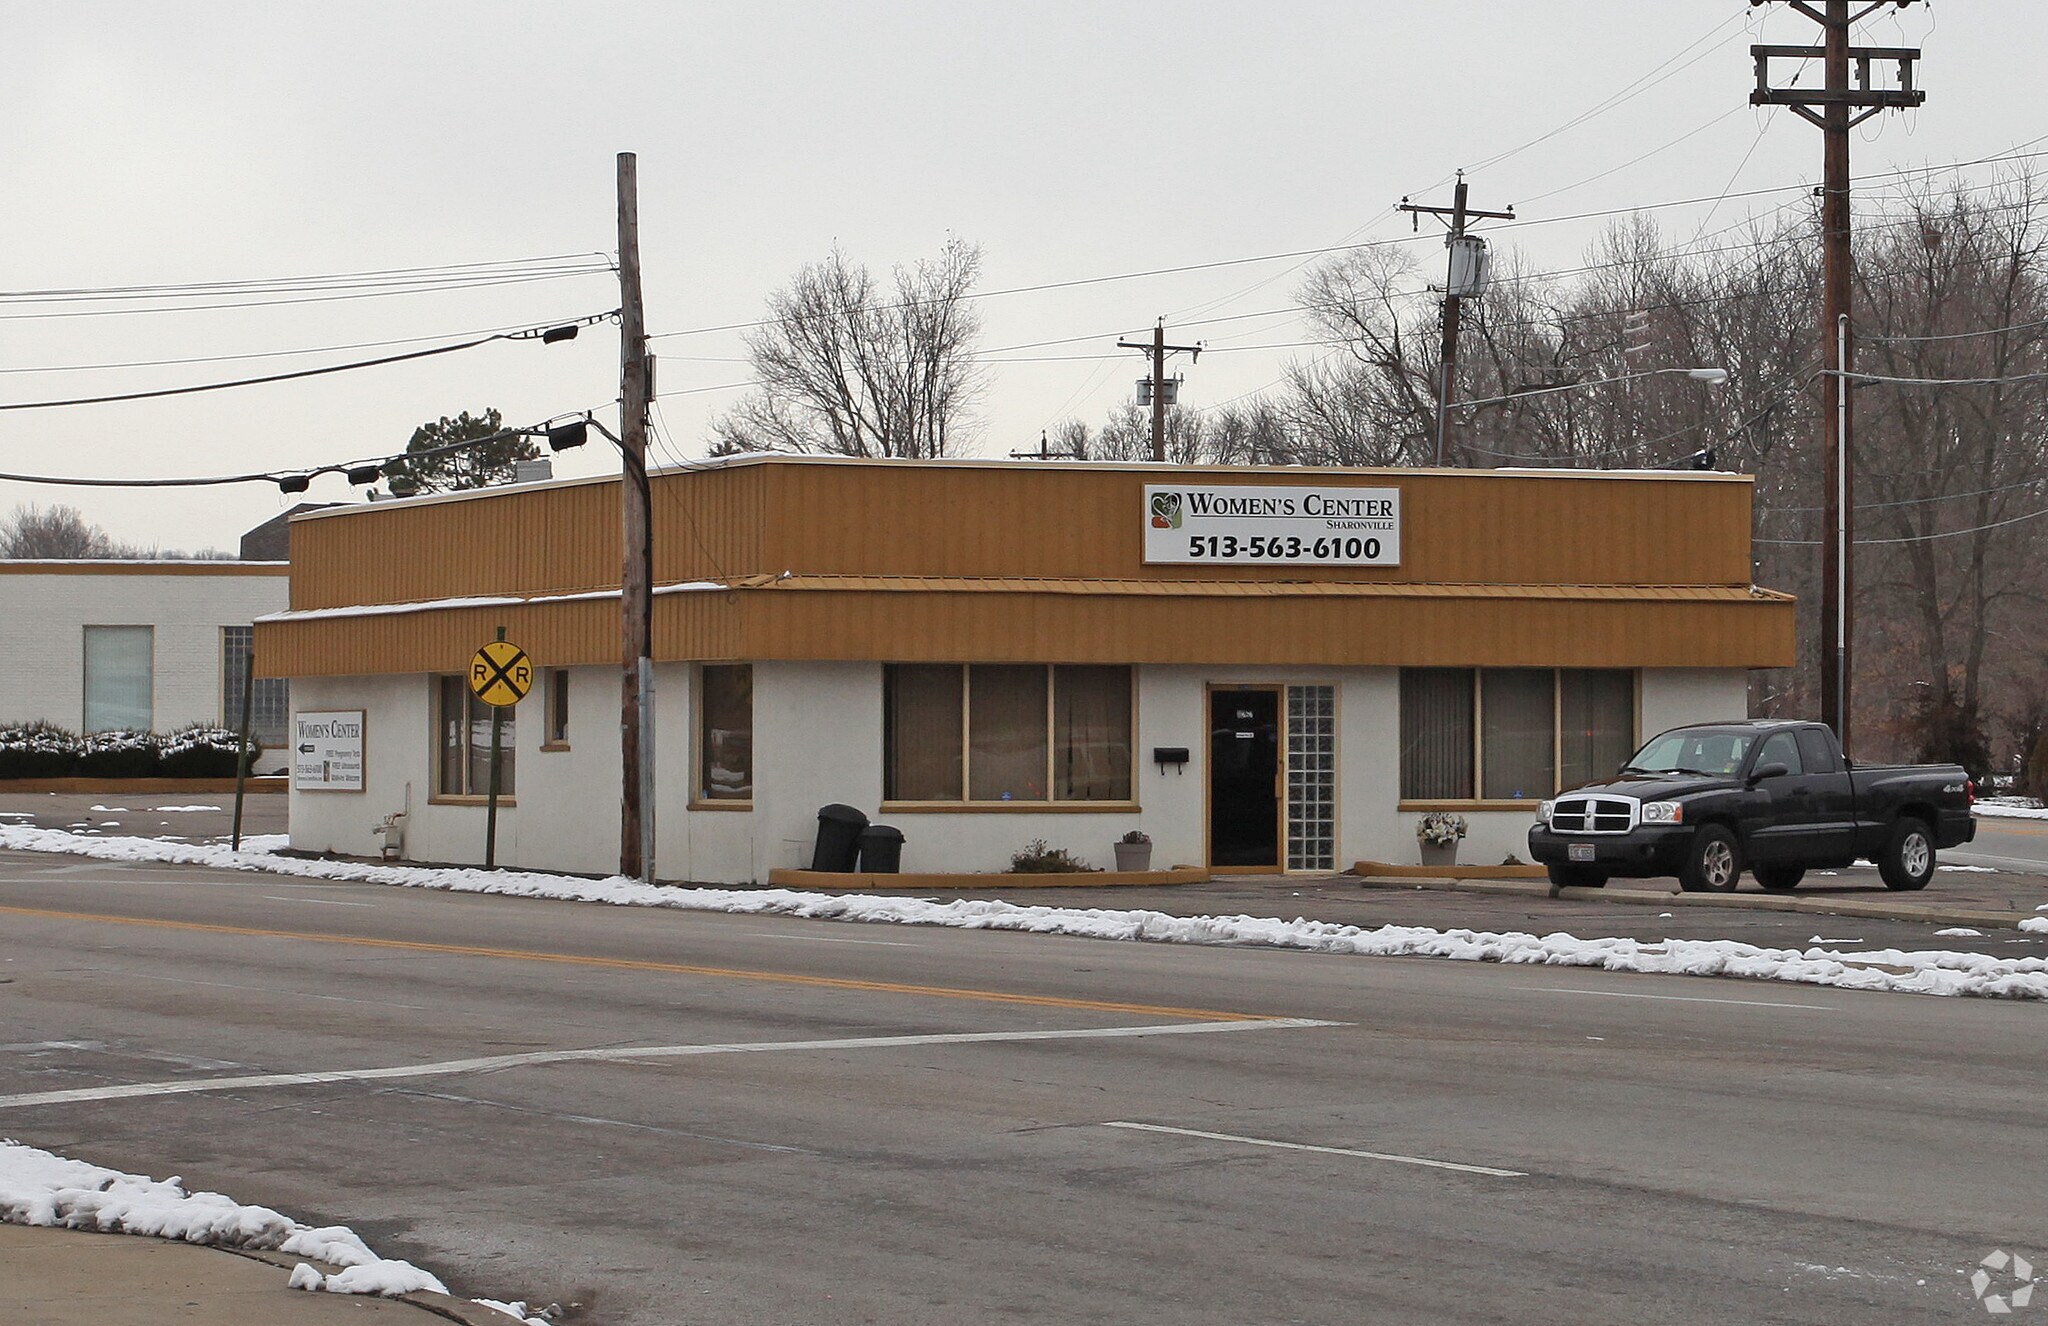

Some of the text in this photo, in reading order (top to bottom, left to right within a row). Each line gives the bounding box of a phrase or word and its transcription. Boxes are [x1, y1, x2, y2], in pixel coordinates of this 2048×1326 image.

[1187, 492, 1394, 517] WOMEN'S CENTER
[1326, 519, 1394, 531] SHARONVILLE
[1188, 536, 1382, 559] 513-563-6100
[474, 664, 529, 683] R R
[298, 720, 360, 738] WOMEN'S CENTER
